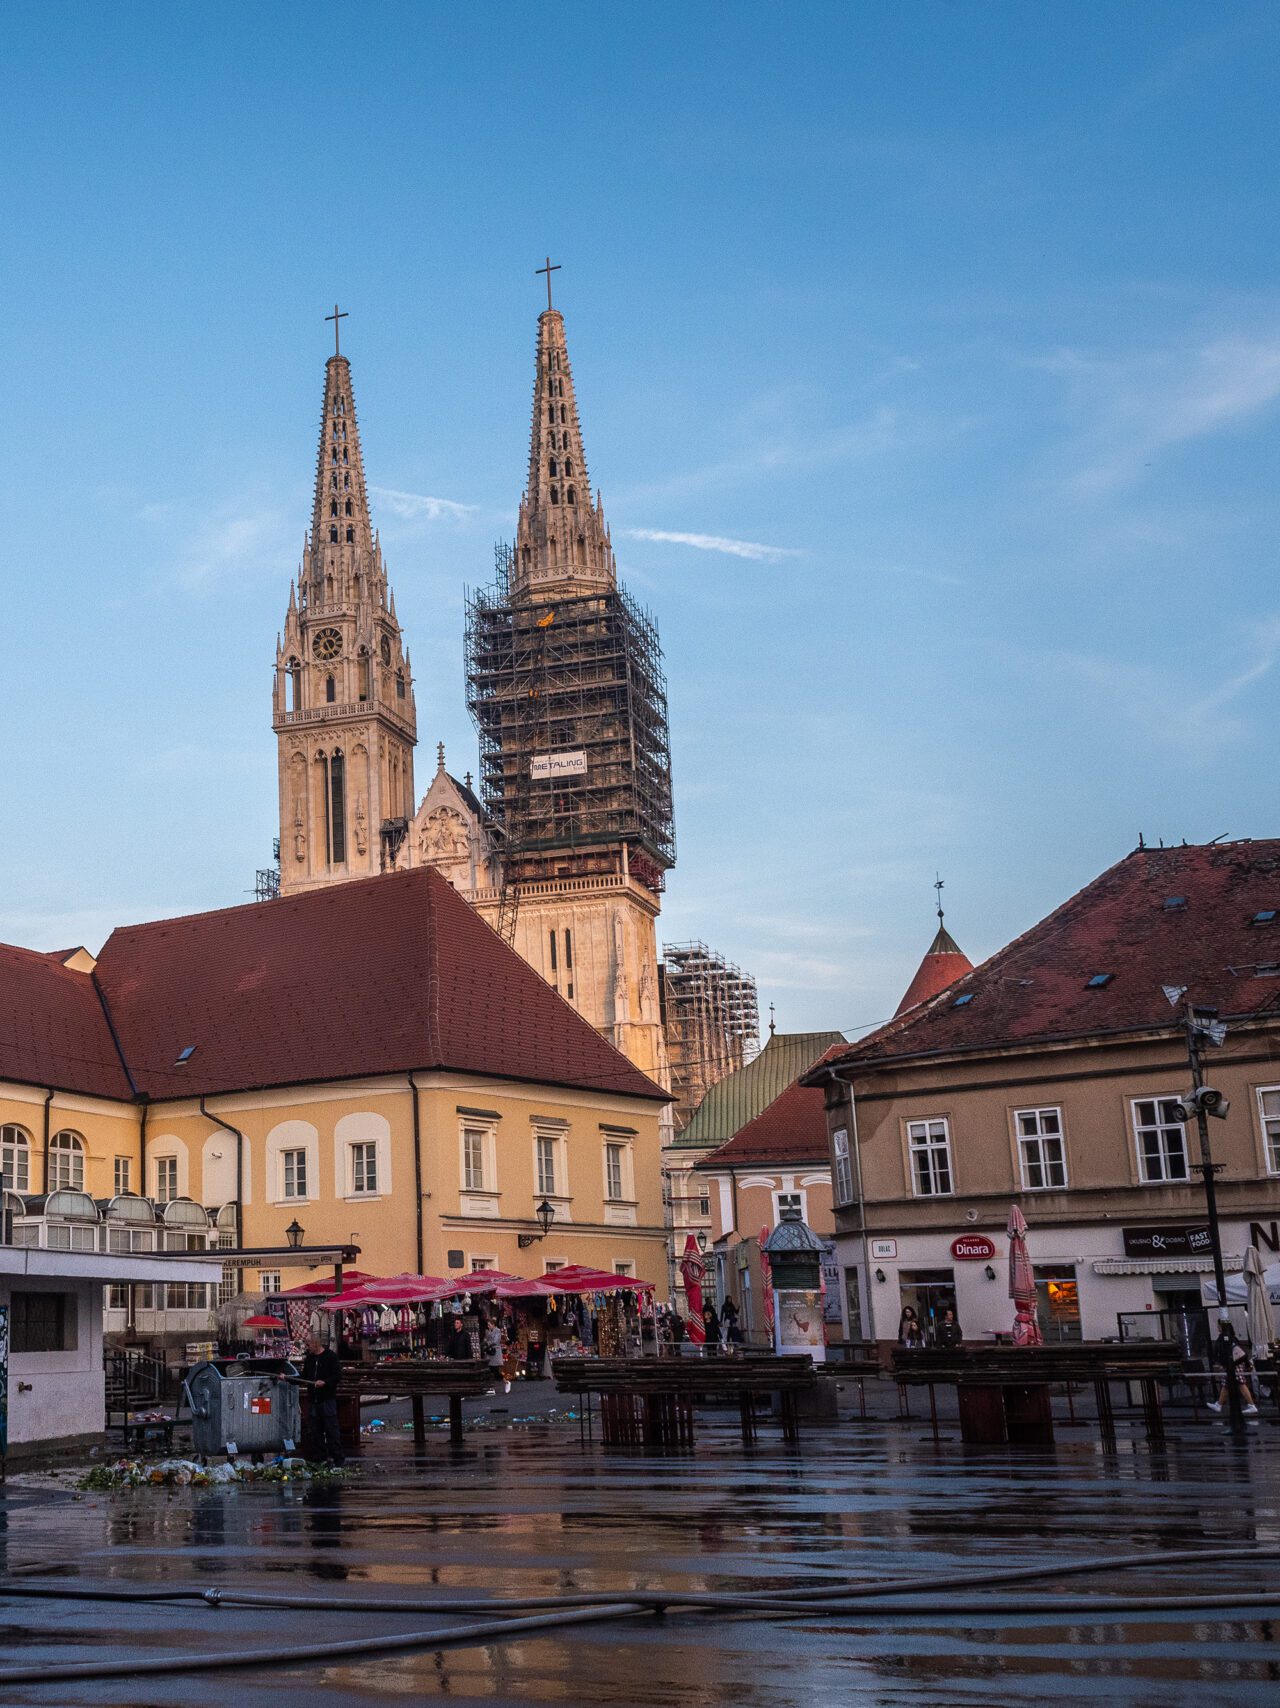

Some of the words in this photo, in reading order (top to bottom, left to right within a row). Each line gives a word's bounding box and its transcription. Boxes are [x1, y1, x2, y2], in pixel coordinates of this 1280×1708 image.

[534, 759, 583, 771] METALING
[1152, 1234, 1167, 1249] &
[1189, 1231, 1208, 1242] FAST
[1192, 1239, 1210, 1248] FOOD
[956, 1244, 990, 1255] Dinara
[223, 1258, 262, 1267] KEREMPUH
